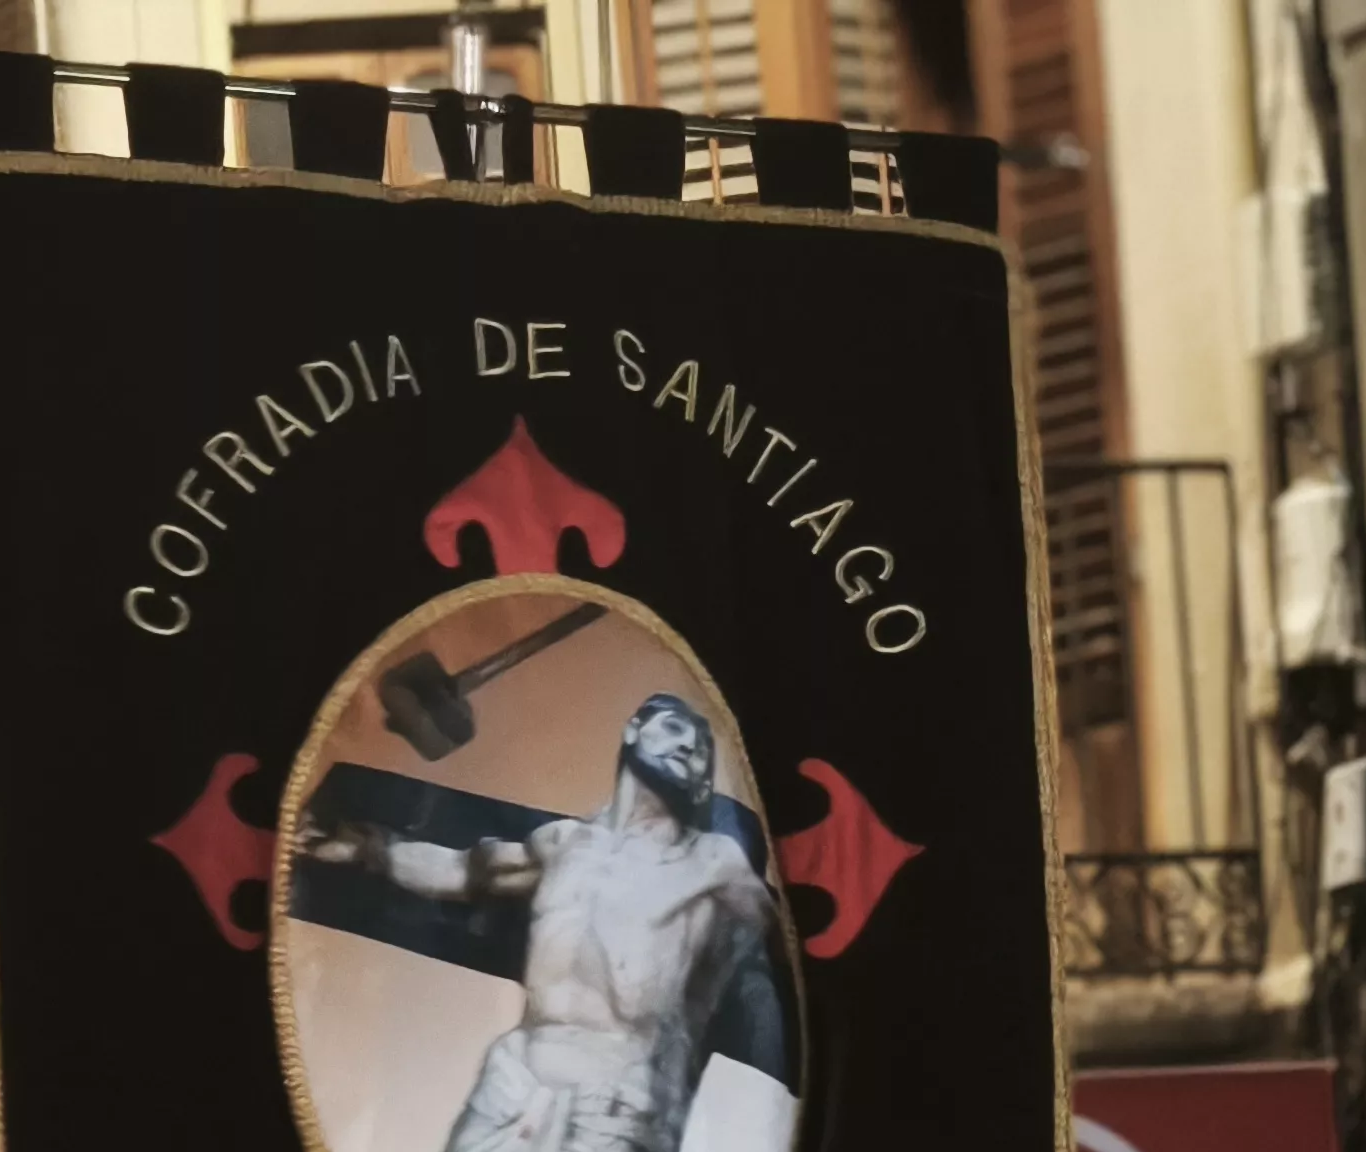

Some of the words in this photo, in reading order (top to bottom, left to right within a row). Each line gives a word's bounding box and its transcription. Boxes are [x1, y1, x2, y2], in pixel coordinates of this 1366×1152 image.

[123, 334, 423, 636] COFRADIA
[473, 317, 571, 379] DE
[613, 328, 927, 654] SANTIAGO
